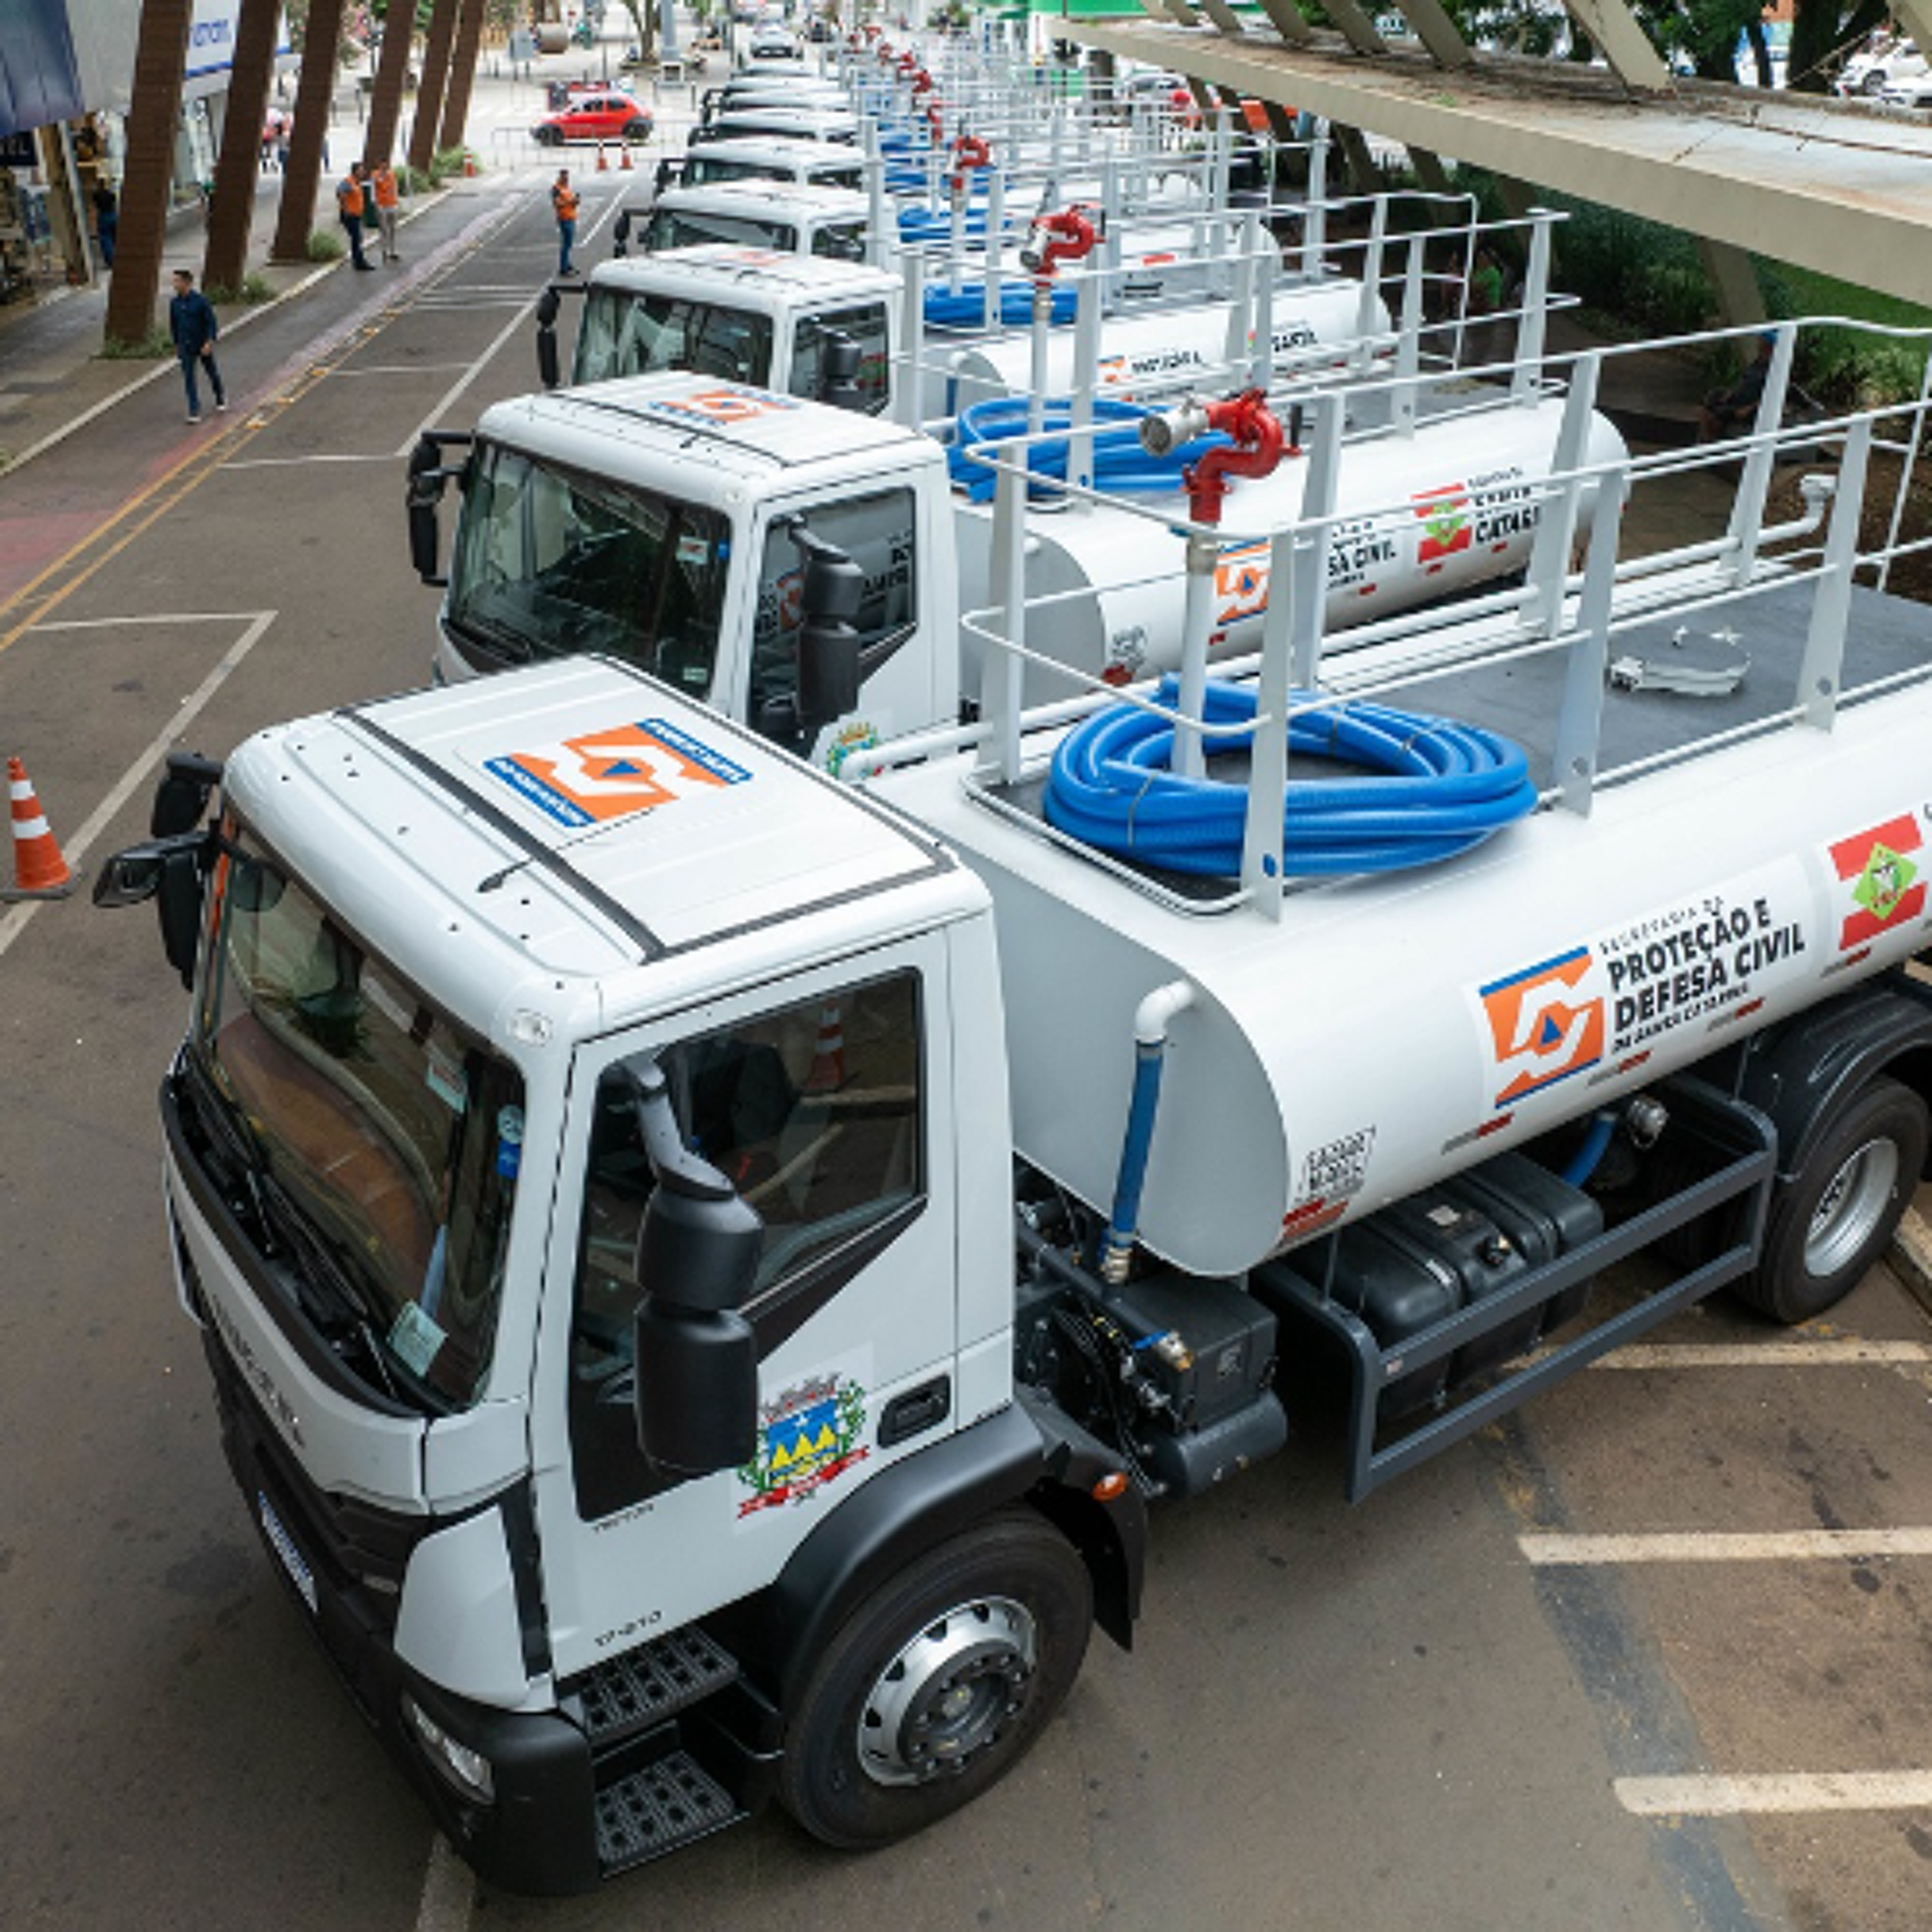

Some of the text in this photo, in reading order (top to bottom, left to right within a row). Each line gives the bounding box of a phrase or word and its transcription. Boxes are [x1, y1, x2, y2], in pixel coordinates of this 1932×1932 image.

[1607, 898, 1772, 993] PROTEÇÃO E
[1615, 923, 1806, 1032] DEFESA CIVIL
